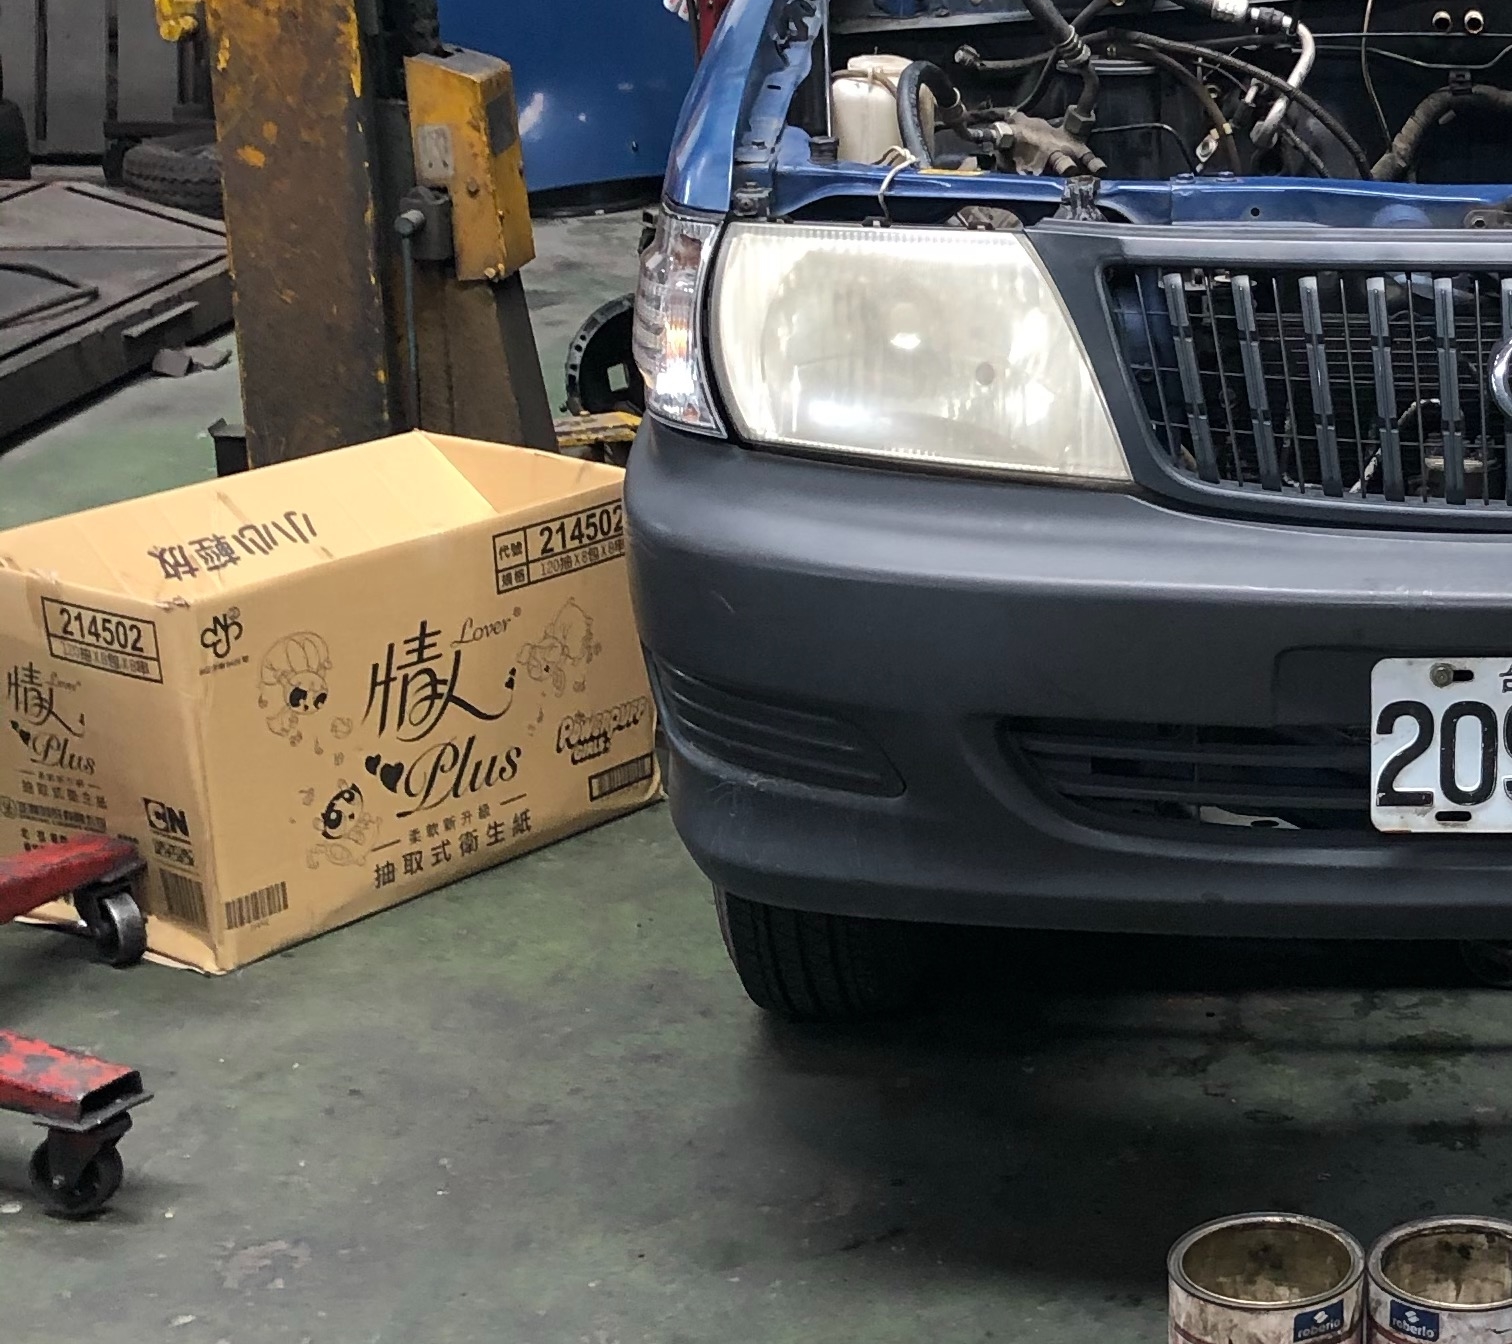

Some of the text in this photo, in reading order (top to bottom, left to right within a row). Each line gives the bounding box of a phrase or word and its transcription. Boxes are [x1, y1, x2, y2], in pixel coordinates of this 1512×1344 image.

[147, 511, 317, 581] 小心輕放
[540, 504, 623, 555] 214502
[59, 608, 144, 653] 214502
[450, 617, 512, 647] Lover
[7, 661, 86, 739] 情人
[361, 620, 517, 742] 情人
[30, 732, 96, 775] Plus
[397, 735, 522, 818] Plus
[374, 808, 532, 889] 抽取式衛生紙
[1392, 1316, 1435, 1339] roberlo
